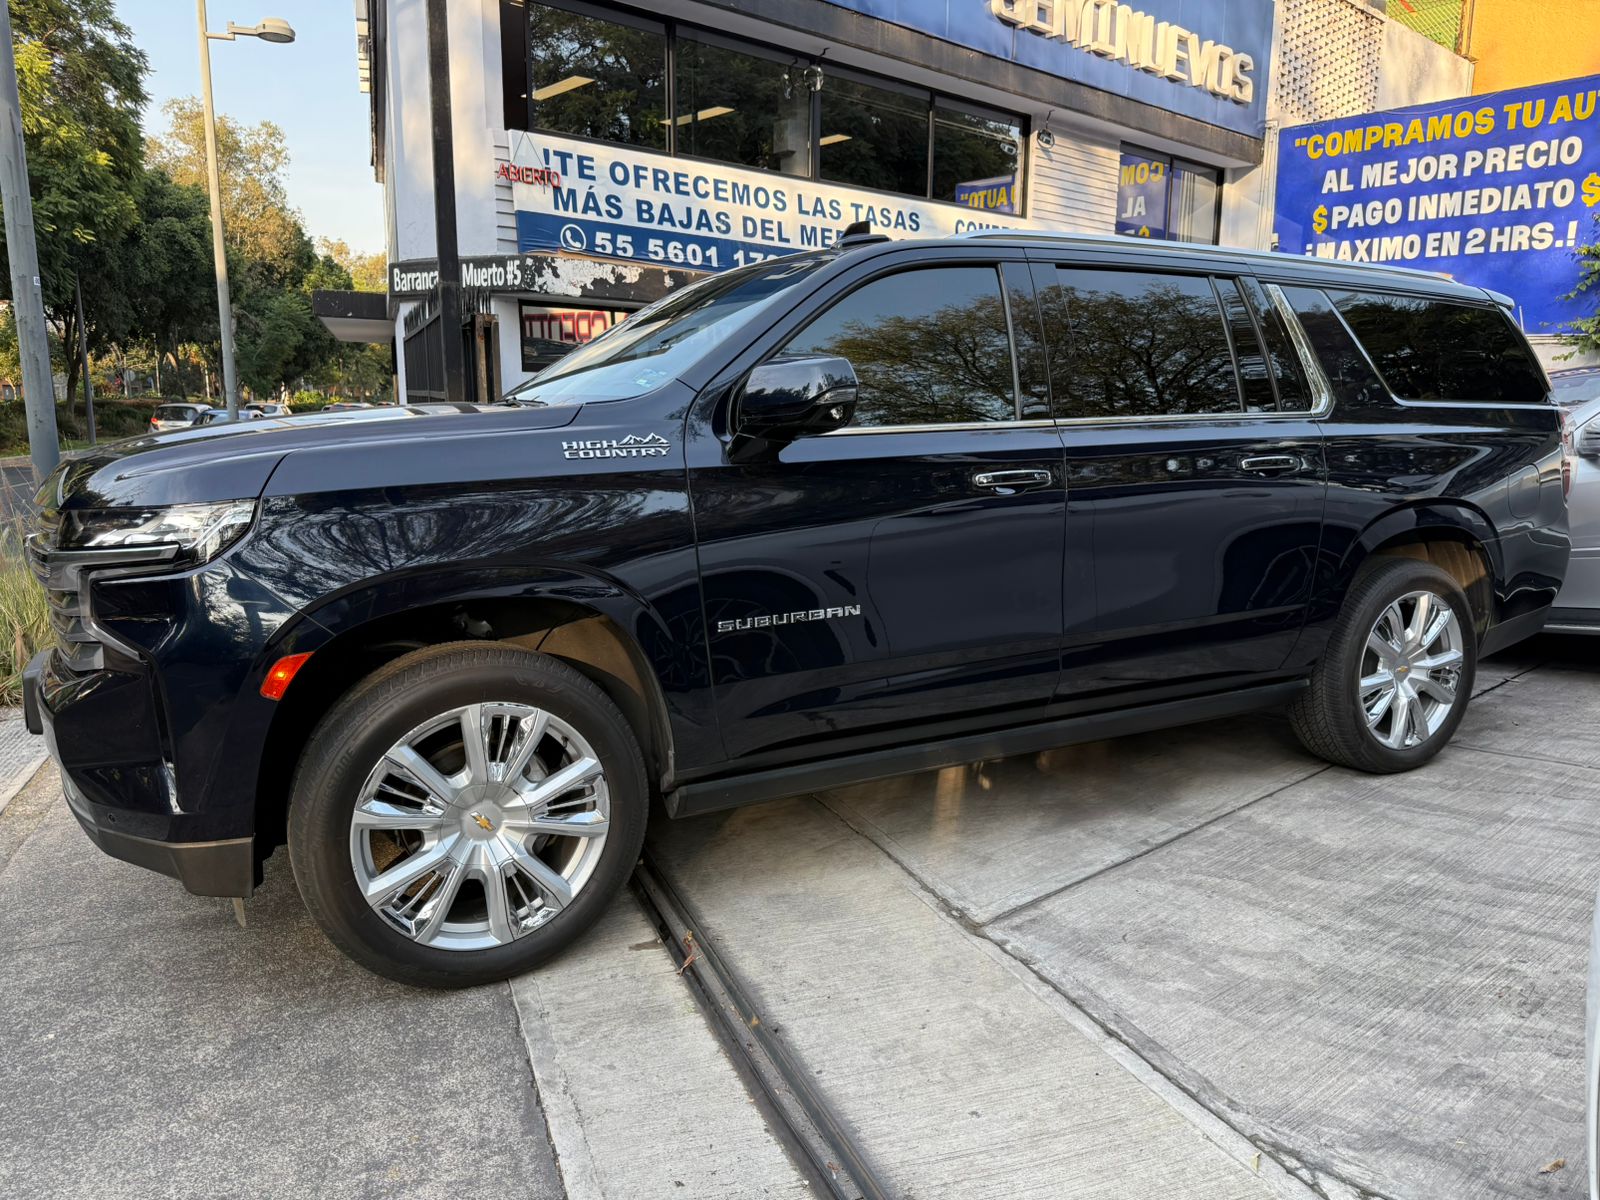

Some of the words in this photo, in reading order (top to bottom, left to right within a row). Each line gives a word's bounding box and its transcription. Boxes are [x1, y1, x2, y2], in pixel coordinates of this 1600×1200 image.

[1504, 99, 1545, 130] TU
[1548, 89, 1600, 125] AU
[497, 162, 561, 188] ABIERTO
[1321, 169, 1354, 194] AL
[1361, 153, 1457, 189] MEJOR
[1463, 136, 1583, 173] PRECIO
[552, 185, 623, 219] MÁS
[636, 199, 731, 235] BAJAS
[742, 215, 790, 243] DEL
[609, 161, 787, 212] OFRECEMOS
[797, 193, 841, 220] LAS
[850, 202, 920, 232] TASAS
[1331, 198, 1403, 230] PAGO
[1408, 178, 1575, 223] INMEDIATO
[594, 232, 634, 257] 55
[648, 238, 719, 267] 5601
[1425, 229, 1462, 257] EN
[1464, 228, 1485, 254] 2
[1489, 220, 1578, 253] HRS.!
[393, 267, 438, 292] Barranca
[462, 262, 505, 289] Muerto
[506, 260, 522, 286] #5
[562, 440, 617, 450] HIGH
[563, 447, 670, 459] COUNTRY
[717, 604, 861, 633] SUBURBAN
